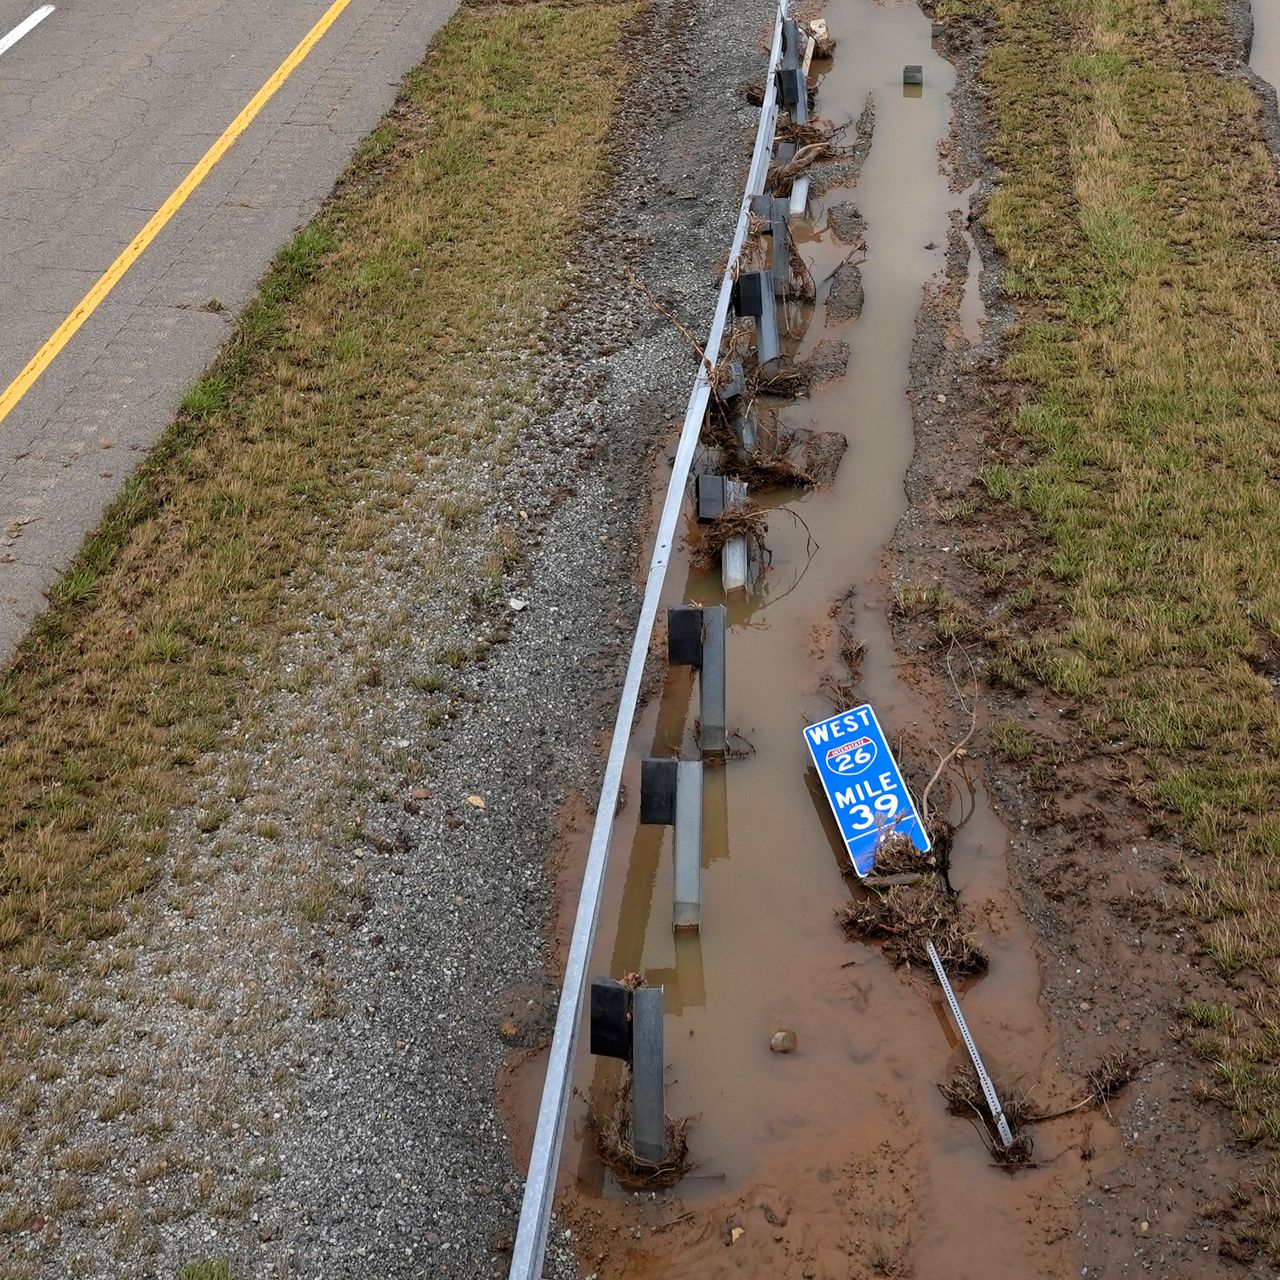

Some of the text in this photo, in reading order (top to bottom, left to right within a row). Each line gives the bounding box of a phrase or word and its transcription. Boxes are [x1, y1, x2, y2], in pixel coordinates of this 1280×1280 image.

[809, 710, 869, 745] WEST
[835, 748, 871, 772] 26
[834, 771, 897, 809] MILE
[849, 793, 898, 830] 39
